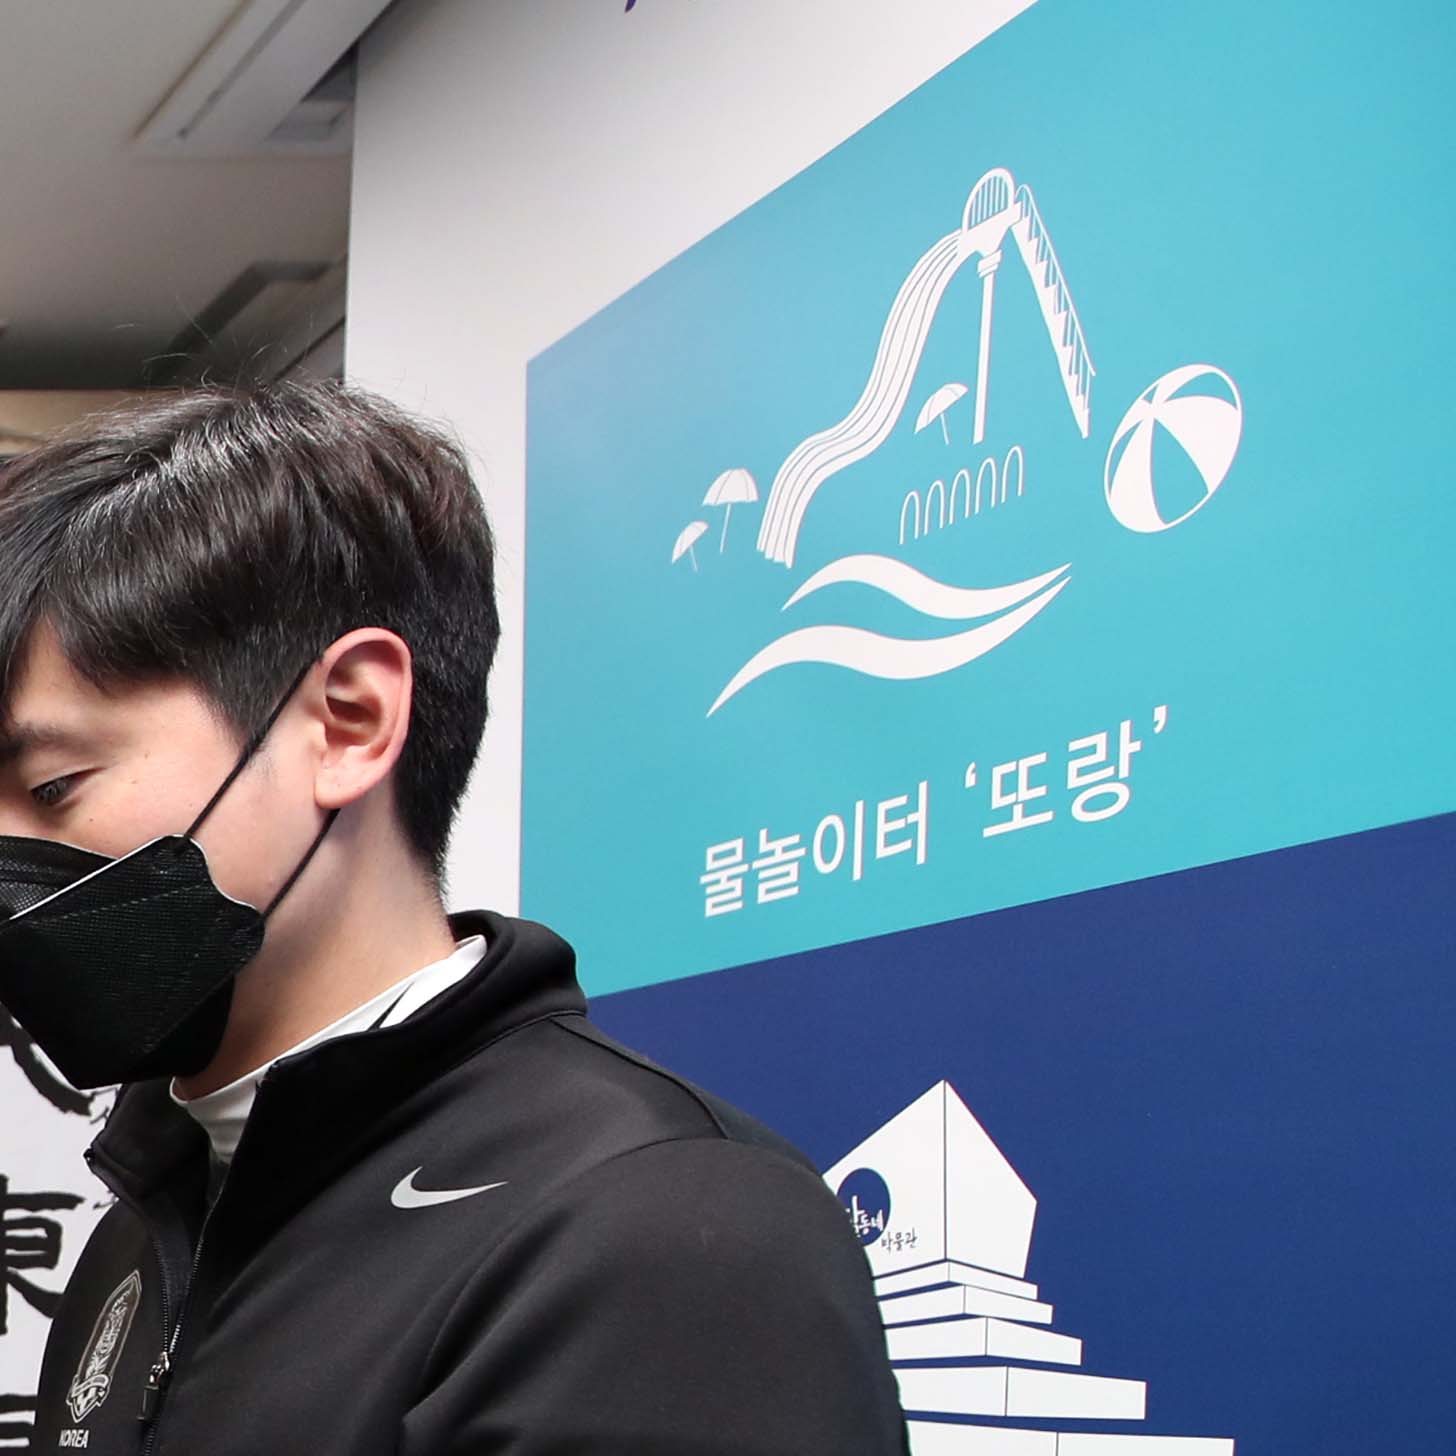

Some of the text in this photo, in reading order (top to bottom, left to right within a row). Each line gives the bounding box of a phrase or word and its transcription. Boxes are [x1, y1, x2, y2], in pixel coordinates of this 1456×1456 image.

[699, 704, 1168, 917] 물놀이터 ‘또랑’
[881, 1226, 917, 1254] 박물관
[58, 1429, 89, 1448] KOREA
